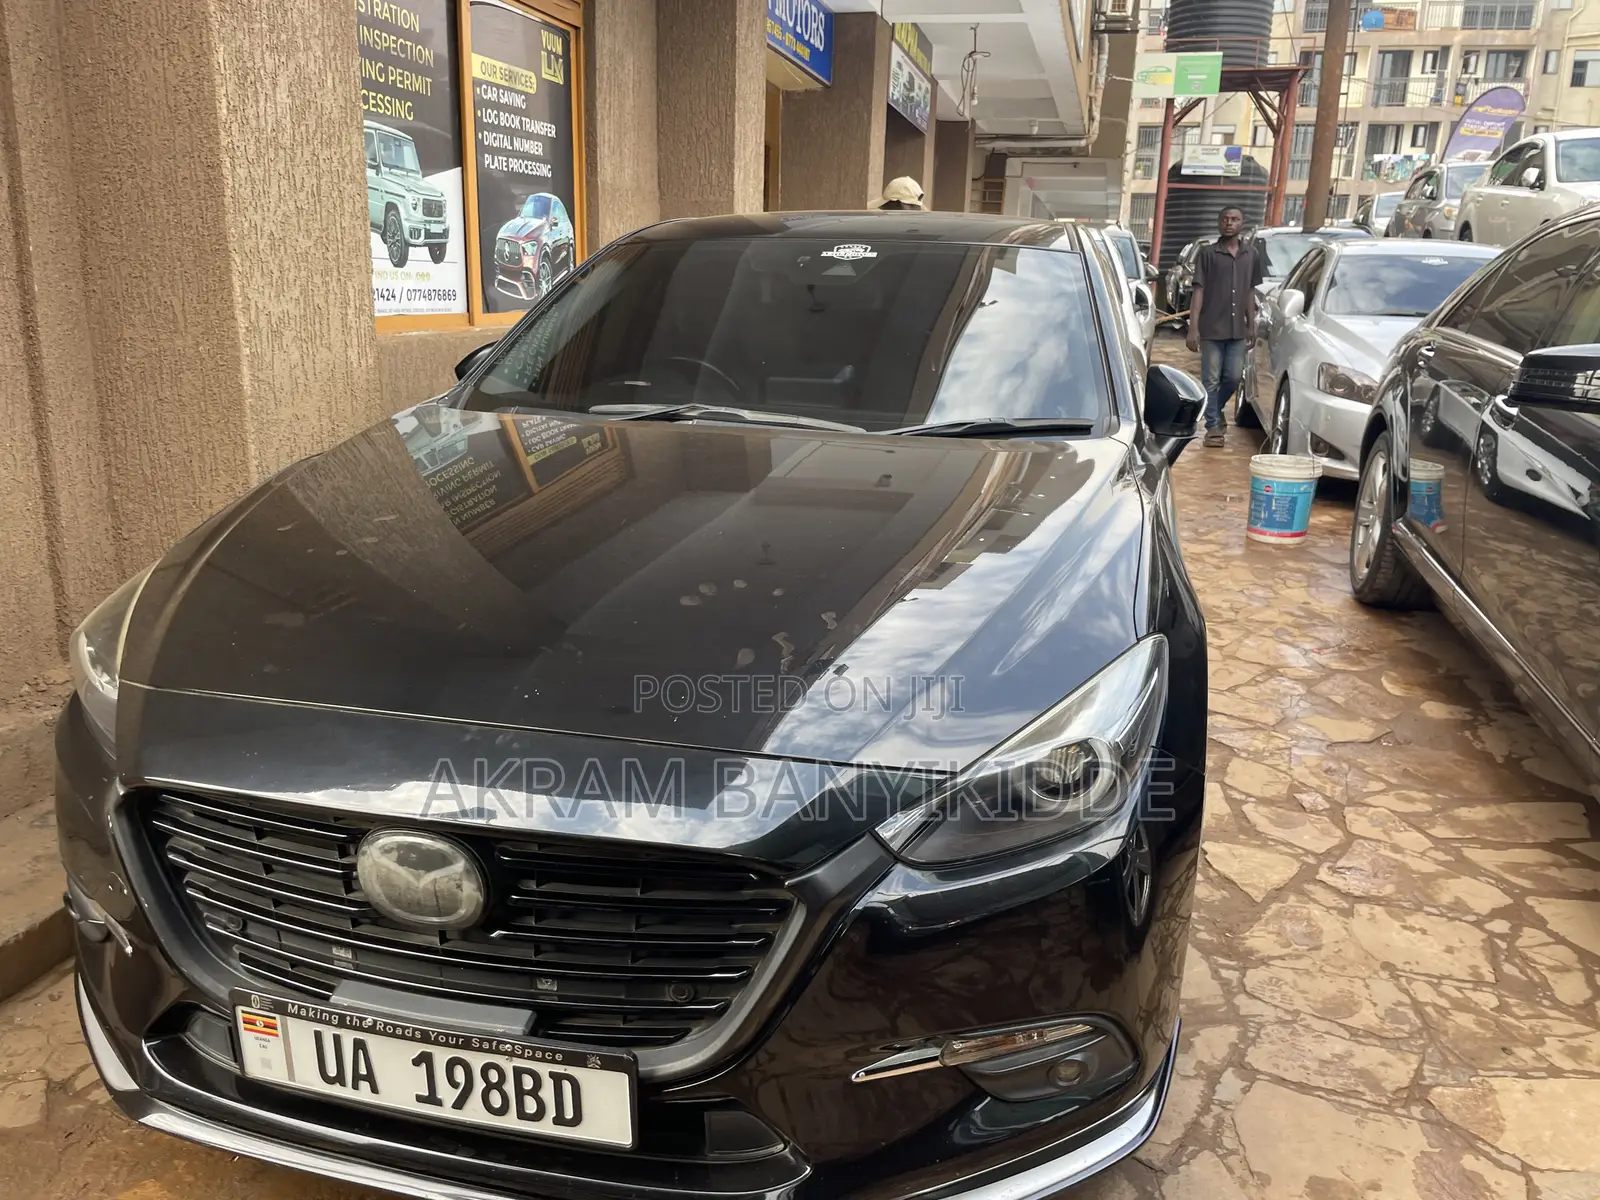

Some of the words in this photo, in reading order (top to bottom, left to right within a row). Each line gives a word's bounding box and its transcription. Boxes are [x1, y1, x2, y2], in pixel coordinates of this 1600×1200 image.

[360, 25, 434, 68] INSPECTION
[359, 57, 385, 83] ING
[388, 66, 432, 97] PERMIT
[480, 61, 497, 80] OUR
[361, 89, 414, 121] CESSING
[481, 84, 498, 102] CAR
[499, 88, 526, 110] SAVING
[482, 108, 498, 125] LOG
[500, 112, 521, 130] BOOK
[521, 117, 556, 139] TRANSFER
[483, 131, 512, 150] DIGITAL
[513, 136, 543, 156] NUMBER
[484, 153, 508, 172] PLATE
[508, 157, 552, 178] PROCESSING
[374, 271, 388, 281] IND
[406, 288, 457, 302] 0774876869
[287, 1003, 339, 1025] Making
[346, 1015, 370, 1029] the
[376, 1022, 422, 1039] Roads
[429, 1030, 464, 1045] Your
[471, 1037, 507, 1052] Safe
[514, 1044, 563, 1061] Space
[313, 1029, 380, 1095] UA
[411, 1050, 583, 1128] 198BD
